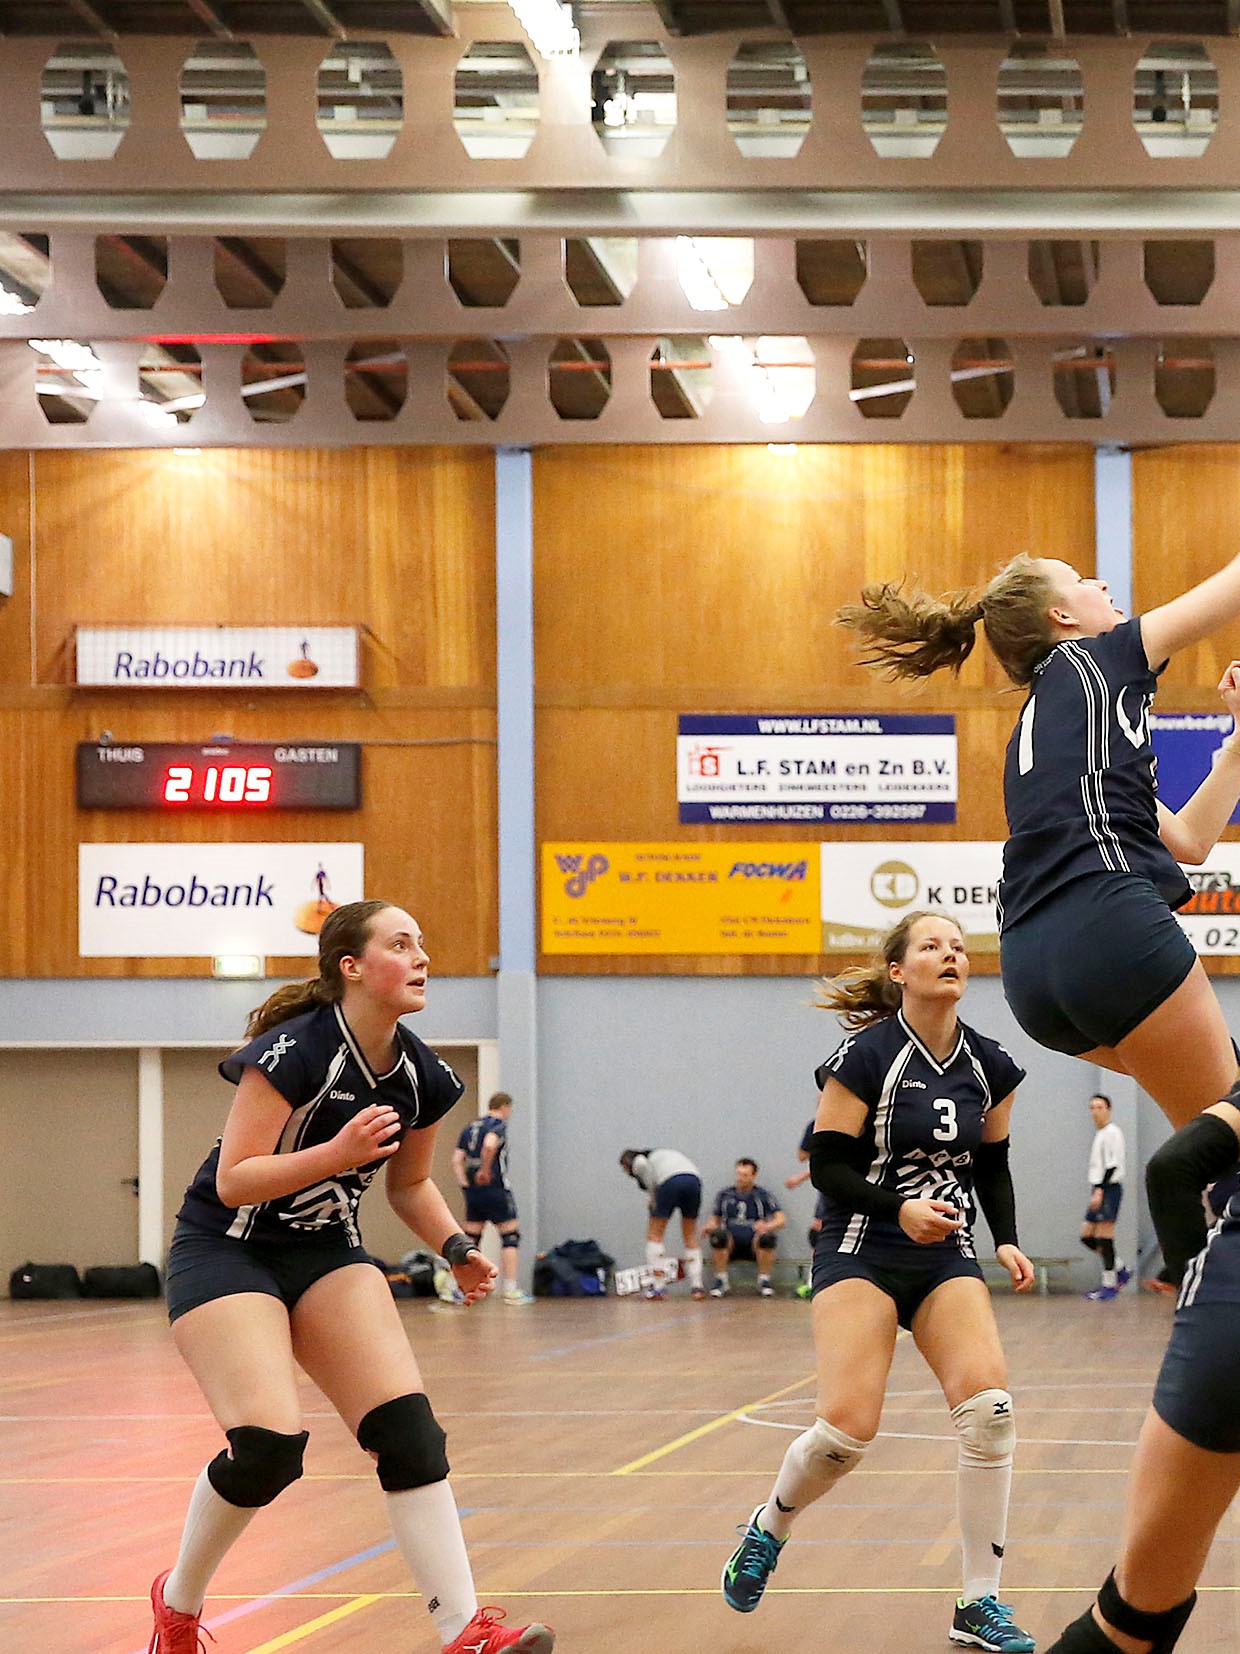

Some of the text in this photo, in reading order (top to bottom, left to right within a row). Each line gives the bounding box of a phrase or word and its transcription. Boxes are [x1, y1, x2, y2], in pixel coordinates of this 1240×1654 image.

[114, 652, 265, 679] Rabobank
[97, 748, 144, 763] THUIS
[273, 748, 339, 763] GASTEN
[737, 760, 951, 776] L.F. STAM en Zn B.V.
[727, 861, 808, 881] FOCWA
[1189, 872, 1229, 892] ers
[95, 875, 275, 907] Rabobank
[928, 887, 998, 904] K DEK
[902, 1080, 927, 1090] Dinto
[330, 1090, 355, 1101] Dinto
[933, 1098, 958, 1141] 3
